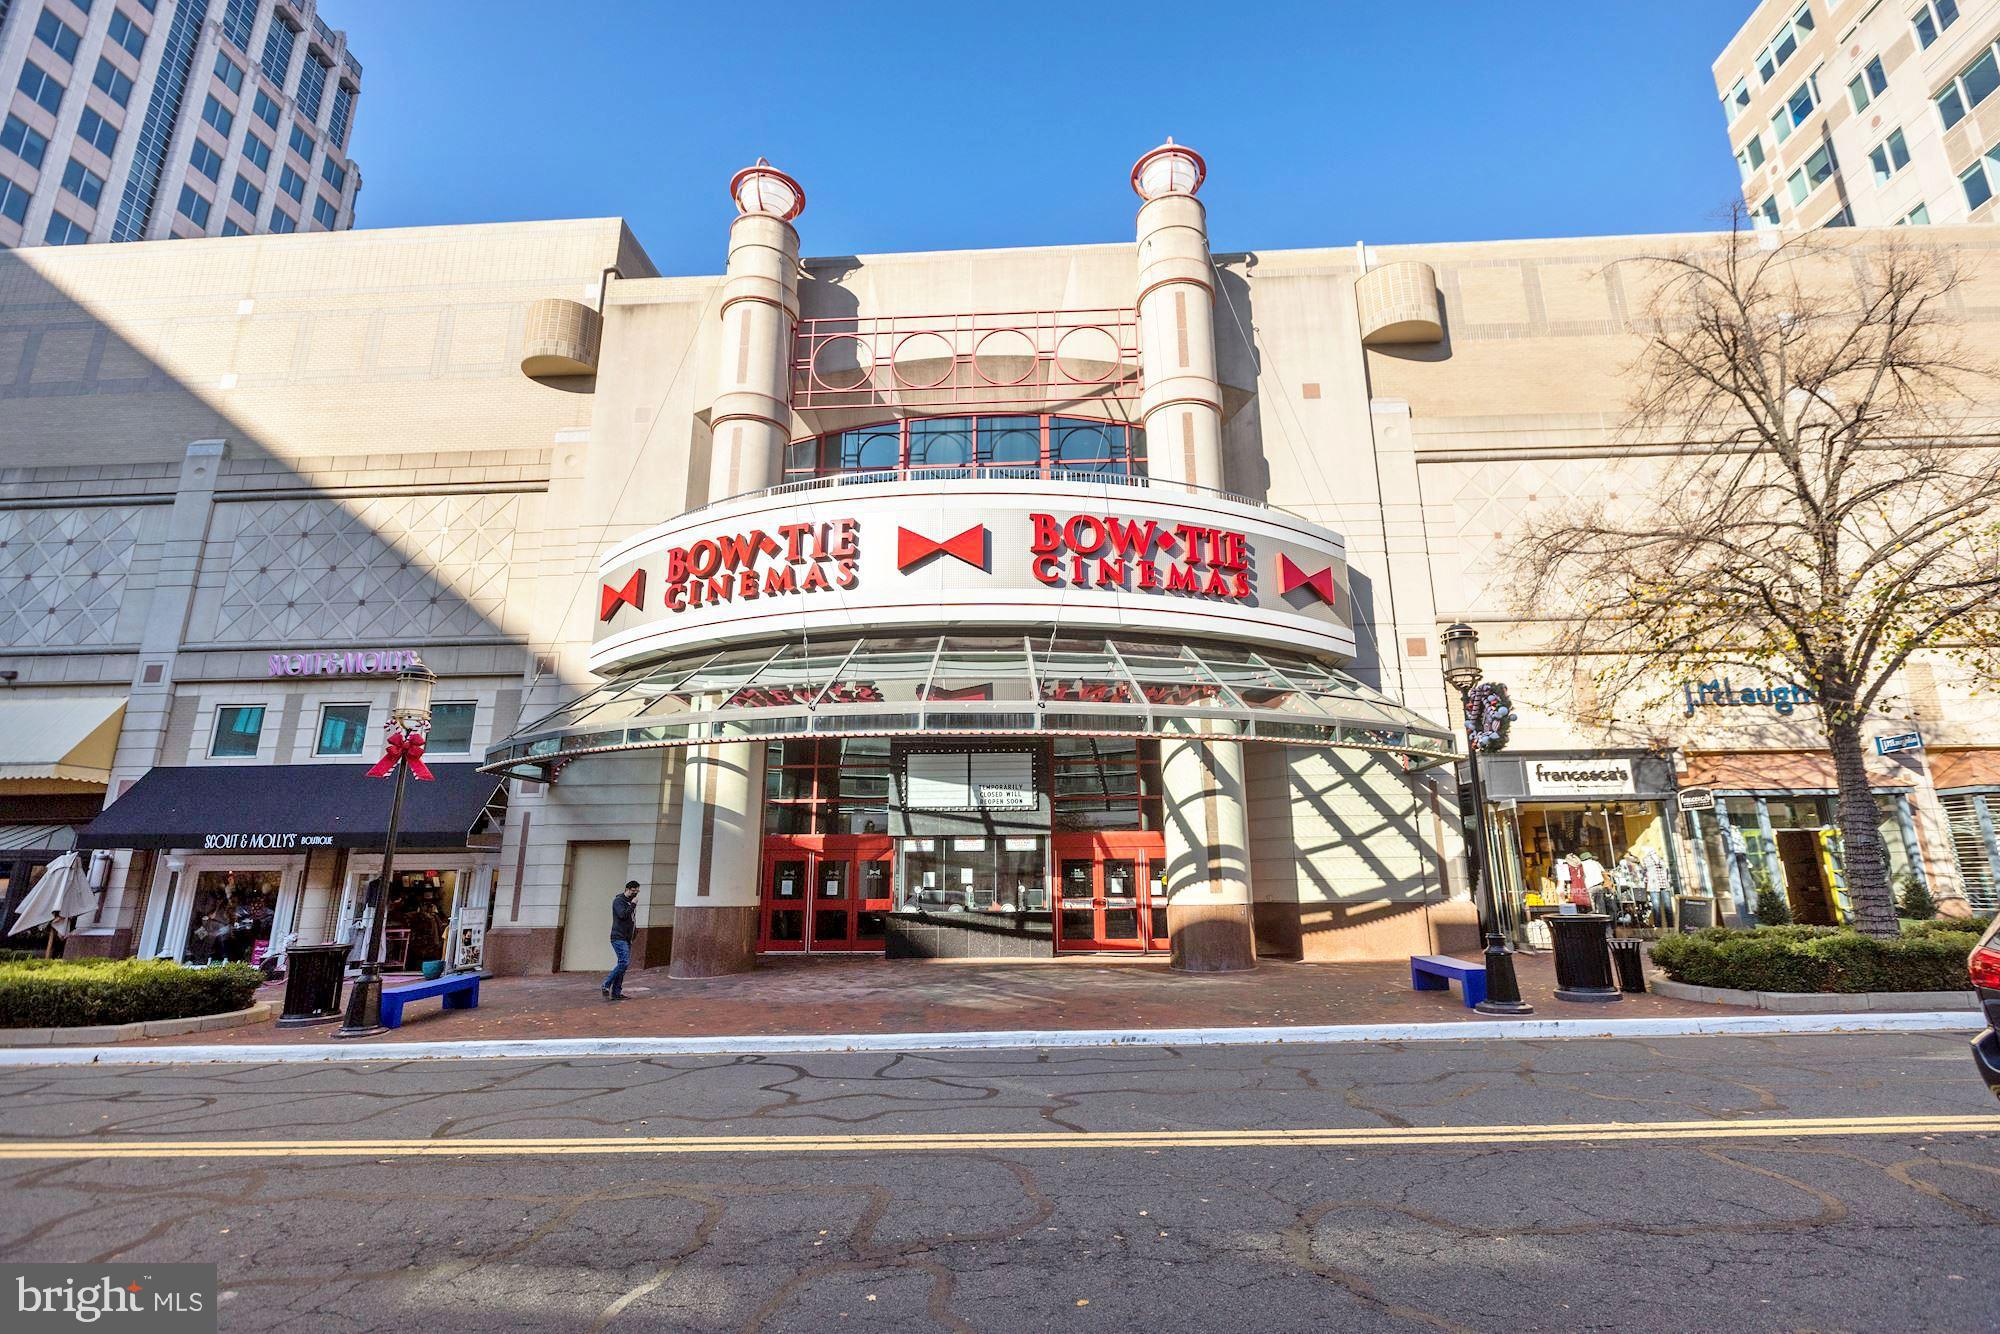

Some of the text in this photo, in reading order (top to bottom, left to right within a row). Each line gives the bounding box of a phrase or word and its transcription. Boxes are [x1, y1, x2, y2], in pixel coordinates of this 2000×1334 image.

[664, 558, 859, 612] CINEMAS
[1032, 555, 1250, 599] CINEMAS
[1683, 677, 1810, 718] J.McLaugh
[1536, 763, 1629, 782] francesca's
[204, 833, 334, 849] SCOUT & MOLLY'S BOUTIQUE
